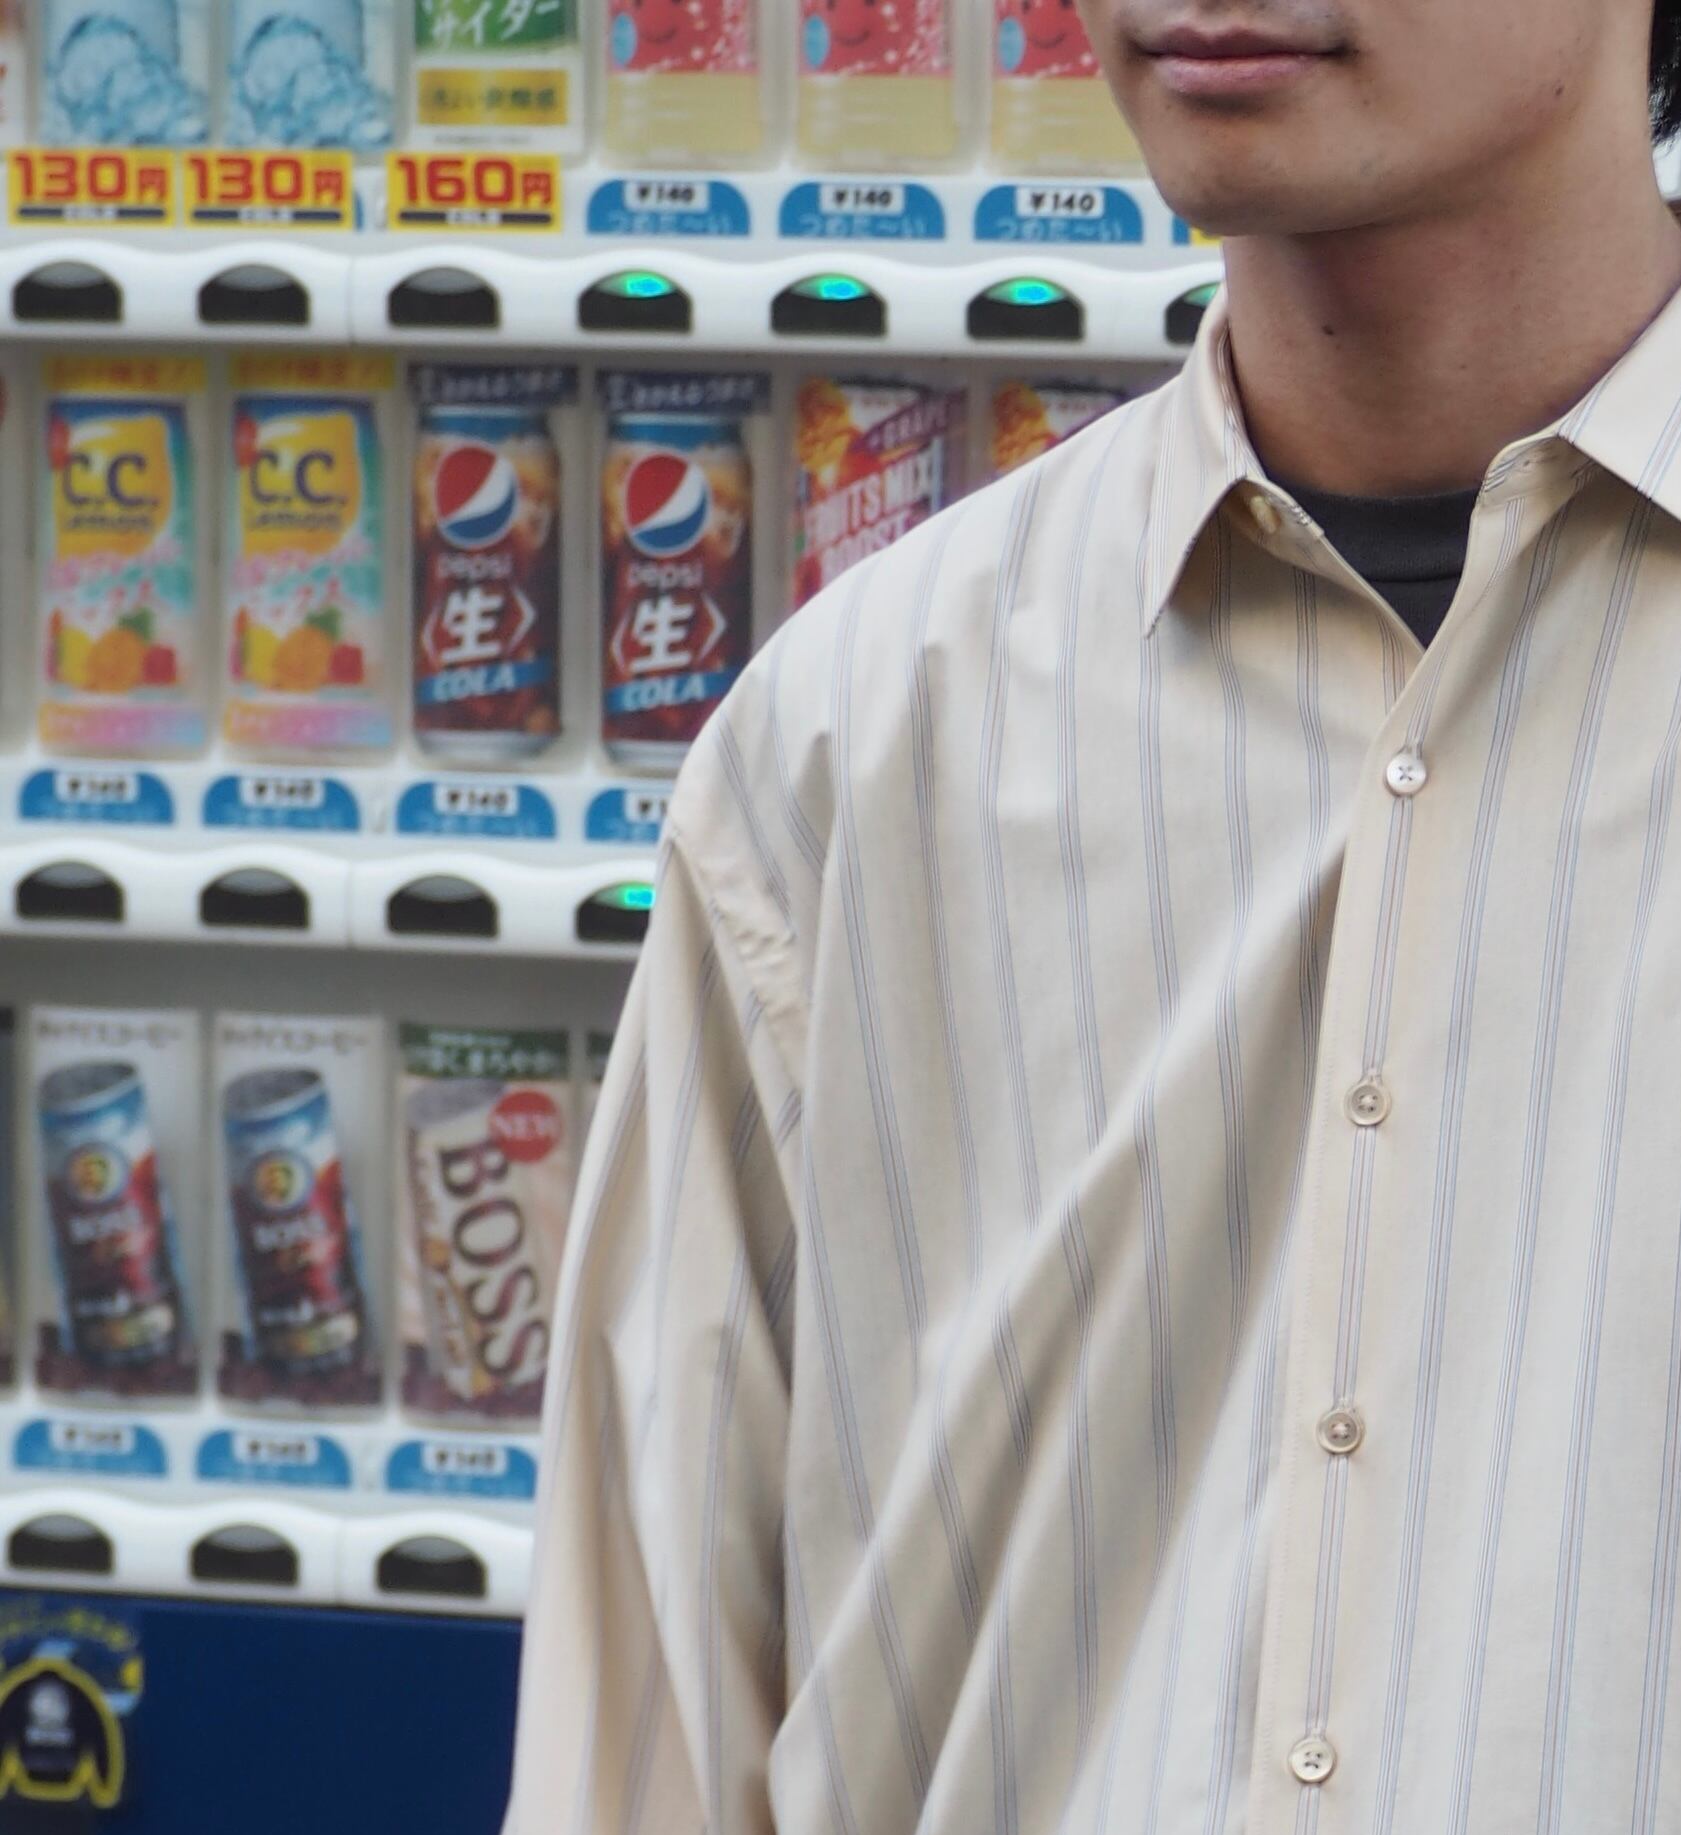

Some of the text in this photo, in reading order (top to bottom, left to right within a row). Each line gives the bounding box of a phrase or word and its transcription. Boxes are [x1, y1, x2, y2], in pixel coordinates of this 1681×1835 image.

[14, 155, 167, 203] 130円
[190, 157, 345, 205] 130円
[397, 158, 553, 207] 160円
[441, 586, 504, 664] 生
[631, 595, 695, 673] 生
[432, 669, 517, 703] COLA
[622, 675, 706, 712] COLA
